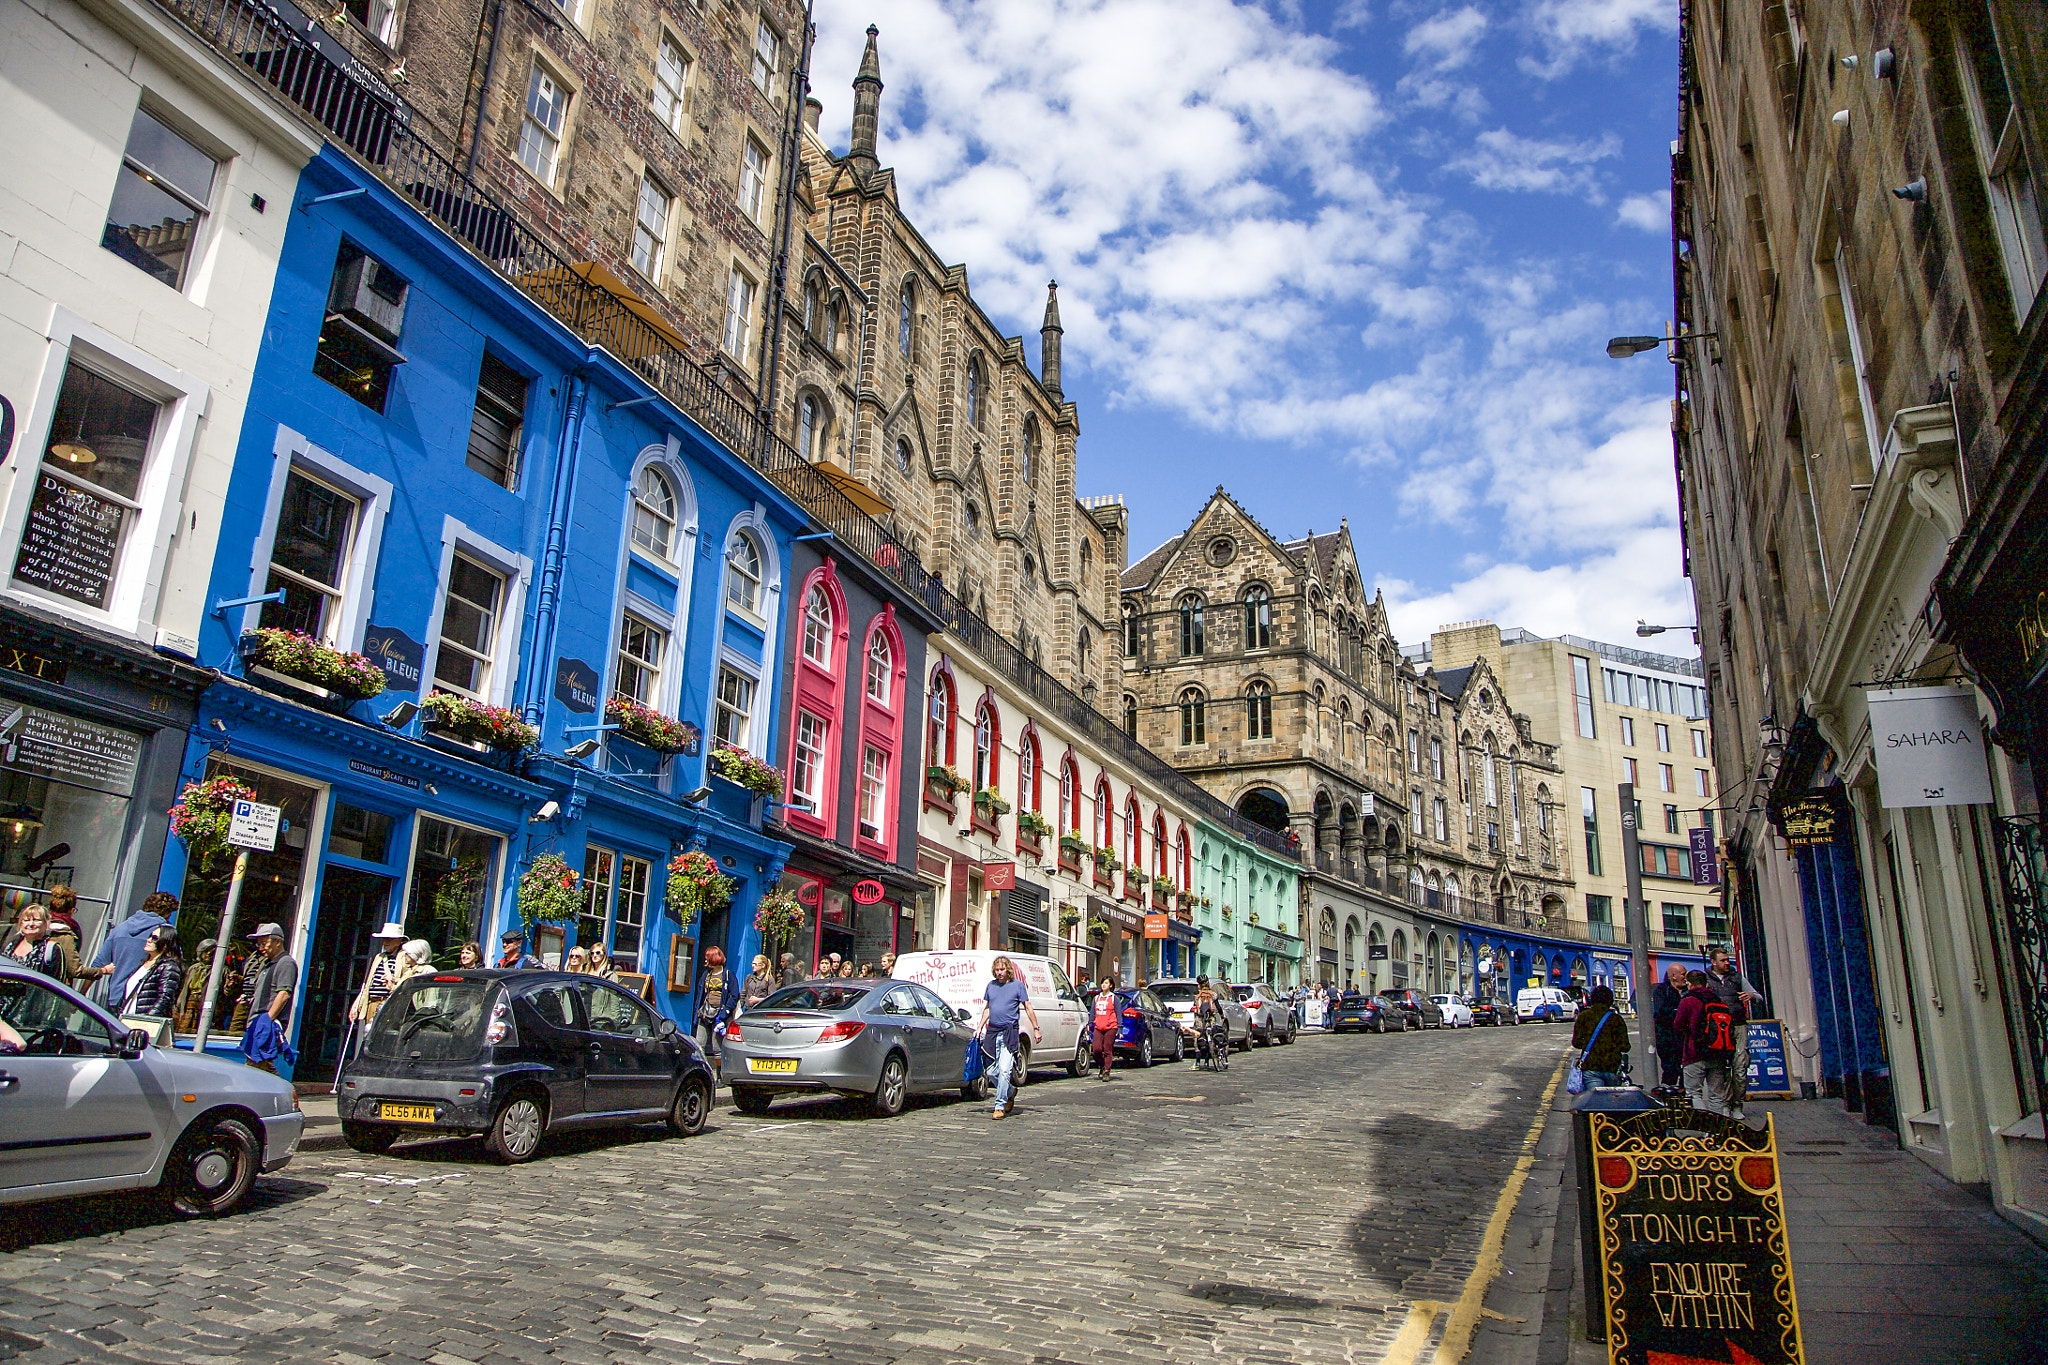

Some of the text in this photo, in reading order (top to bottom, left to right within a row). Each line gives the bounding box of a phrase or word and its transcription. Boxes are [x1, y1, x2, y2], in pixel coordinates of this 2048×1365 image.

[340, 62, 382, 97] MIDD
[351, 57, 394, 99] KURDISH
[45, 504, 110, 535] to explore our
[55, 496, 105, 521] AFRAID
[103, 504, 121, 518] BE
[31, 522, 112, 558] many and varied.
[33, 511, 116, 549] shop. Our stock is
[31, 533, 108, 568] We have items to
[20, 565, 51, 581] depth
[53, 577, 66, 587] of
[28, 557, 41, 566] of
[50, 564, 81, 580] purse
[82, 576, 101, 588] and
[40, 548, 56, 560] all
[57, 556, 114, 582] dimensions
[366, 637, 406, 661] Maison
[385, 657, 419, 683] BLEUE
[557, 669, 587, 691] Maison
[149, 694, 169, 714] 40
[572, 688, 597, 707] BLEUE
[30, 709, 69, 726] Antique,
[73, 720, 110, 736] Vintage,
[22, 740, 32, 748] We
[25, 727, 135, 761] Scottish Art and Design.
[73, 730, 92, 741] and
[1886, 729, 1971, 749] SAHARA
[351, 761, 383, 775] RESTAURANT
[407, 778, 418, 786] BAR
[1781, 805, 1797, 818] The
[1818, 802, 1836, 815] Bar
[235, 831, 253, 839] Display
[252, 821, 274, 829] machine
[281, 818, 290, 833] B
[241, 838, 252, 846] stay
[1790, 837, 1808, 845] FREE
[1696, 863, 1714, 884] long
[1101, 905, 1110, 915] THE
[1126, 915, 1137, 925] SHOP
[1760, 1029, 1779, 1039] BAR
[756, 1060, 792, 1070] YT13 PCY
[385, 1105, 409, 1118] SL56
[1638, 1174, 1733, 1201] TOURS
[1620, 1213, 1763, 1245] TONIGHT:
[1650, 1262, 1750, 1296] ENQUIRE
[1650, 1292, 1755, 1330] WITHIN
